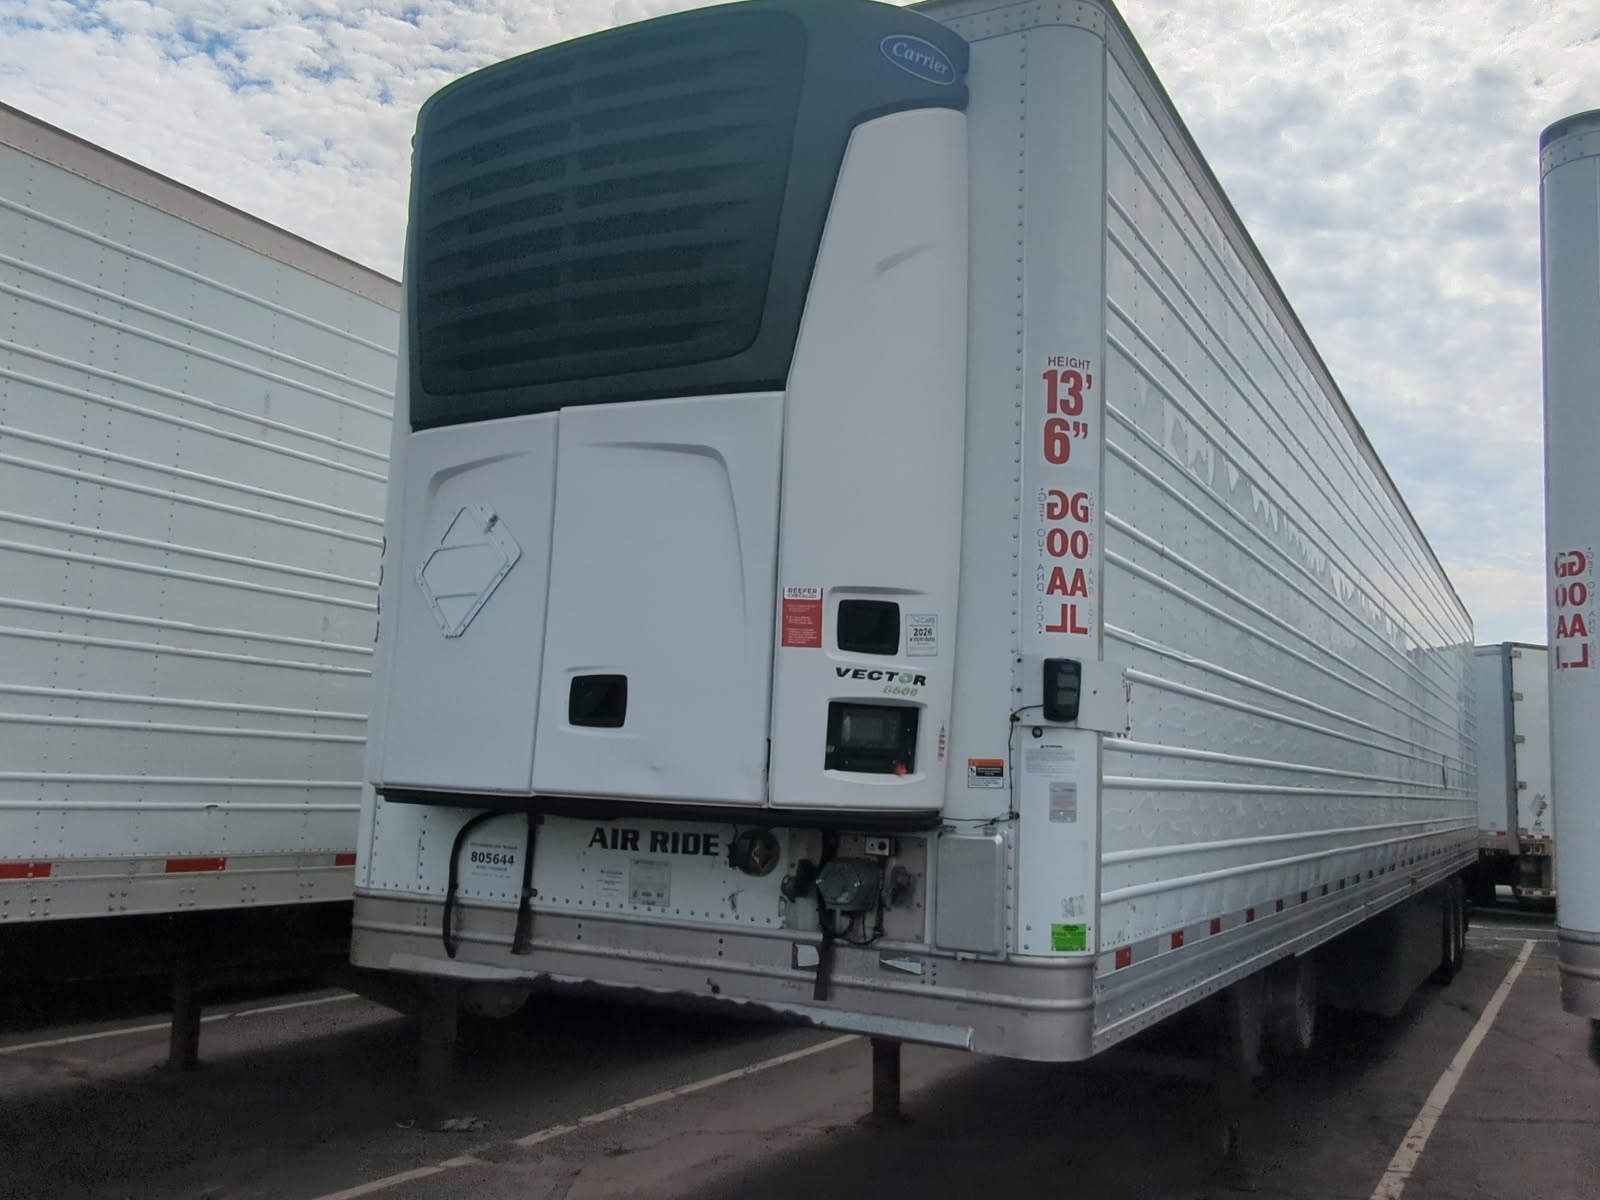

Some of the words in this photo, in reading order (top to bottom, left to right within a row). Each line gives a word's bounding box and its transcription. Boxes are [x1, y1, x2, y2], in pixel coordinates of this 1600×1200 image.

[891, 41, 950, 76] Carrier
[1047, 356, 1091, 371] HEIGHT
[1042, 369, 1093, 417] 13'
[913, 627, 933, 637] 2026
[835, 667, 927, 687] VECTOR
[588, 827, 640, 852] AIR
[649, 830, 720, 856] RIDE
[471, 851, 514, 865] 805644
